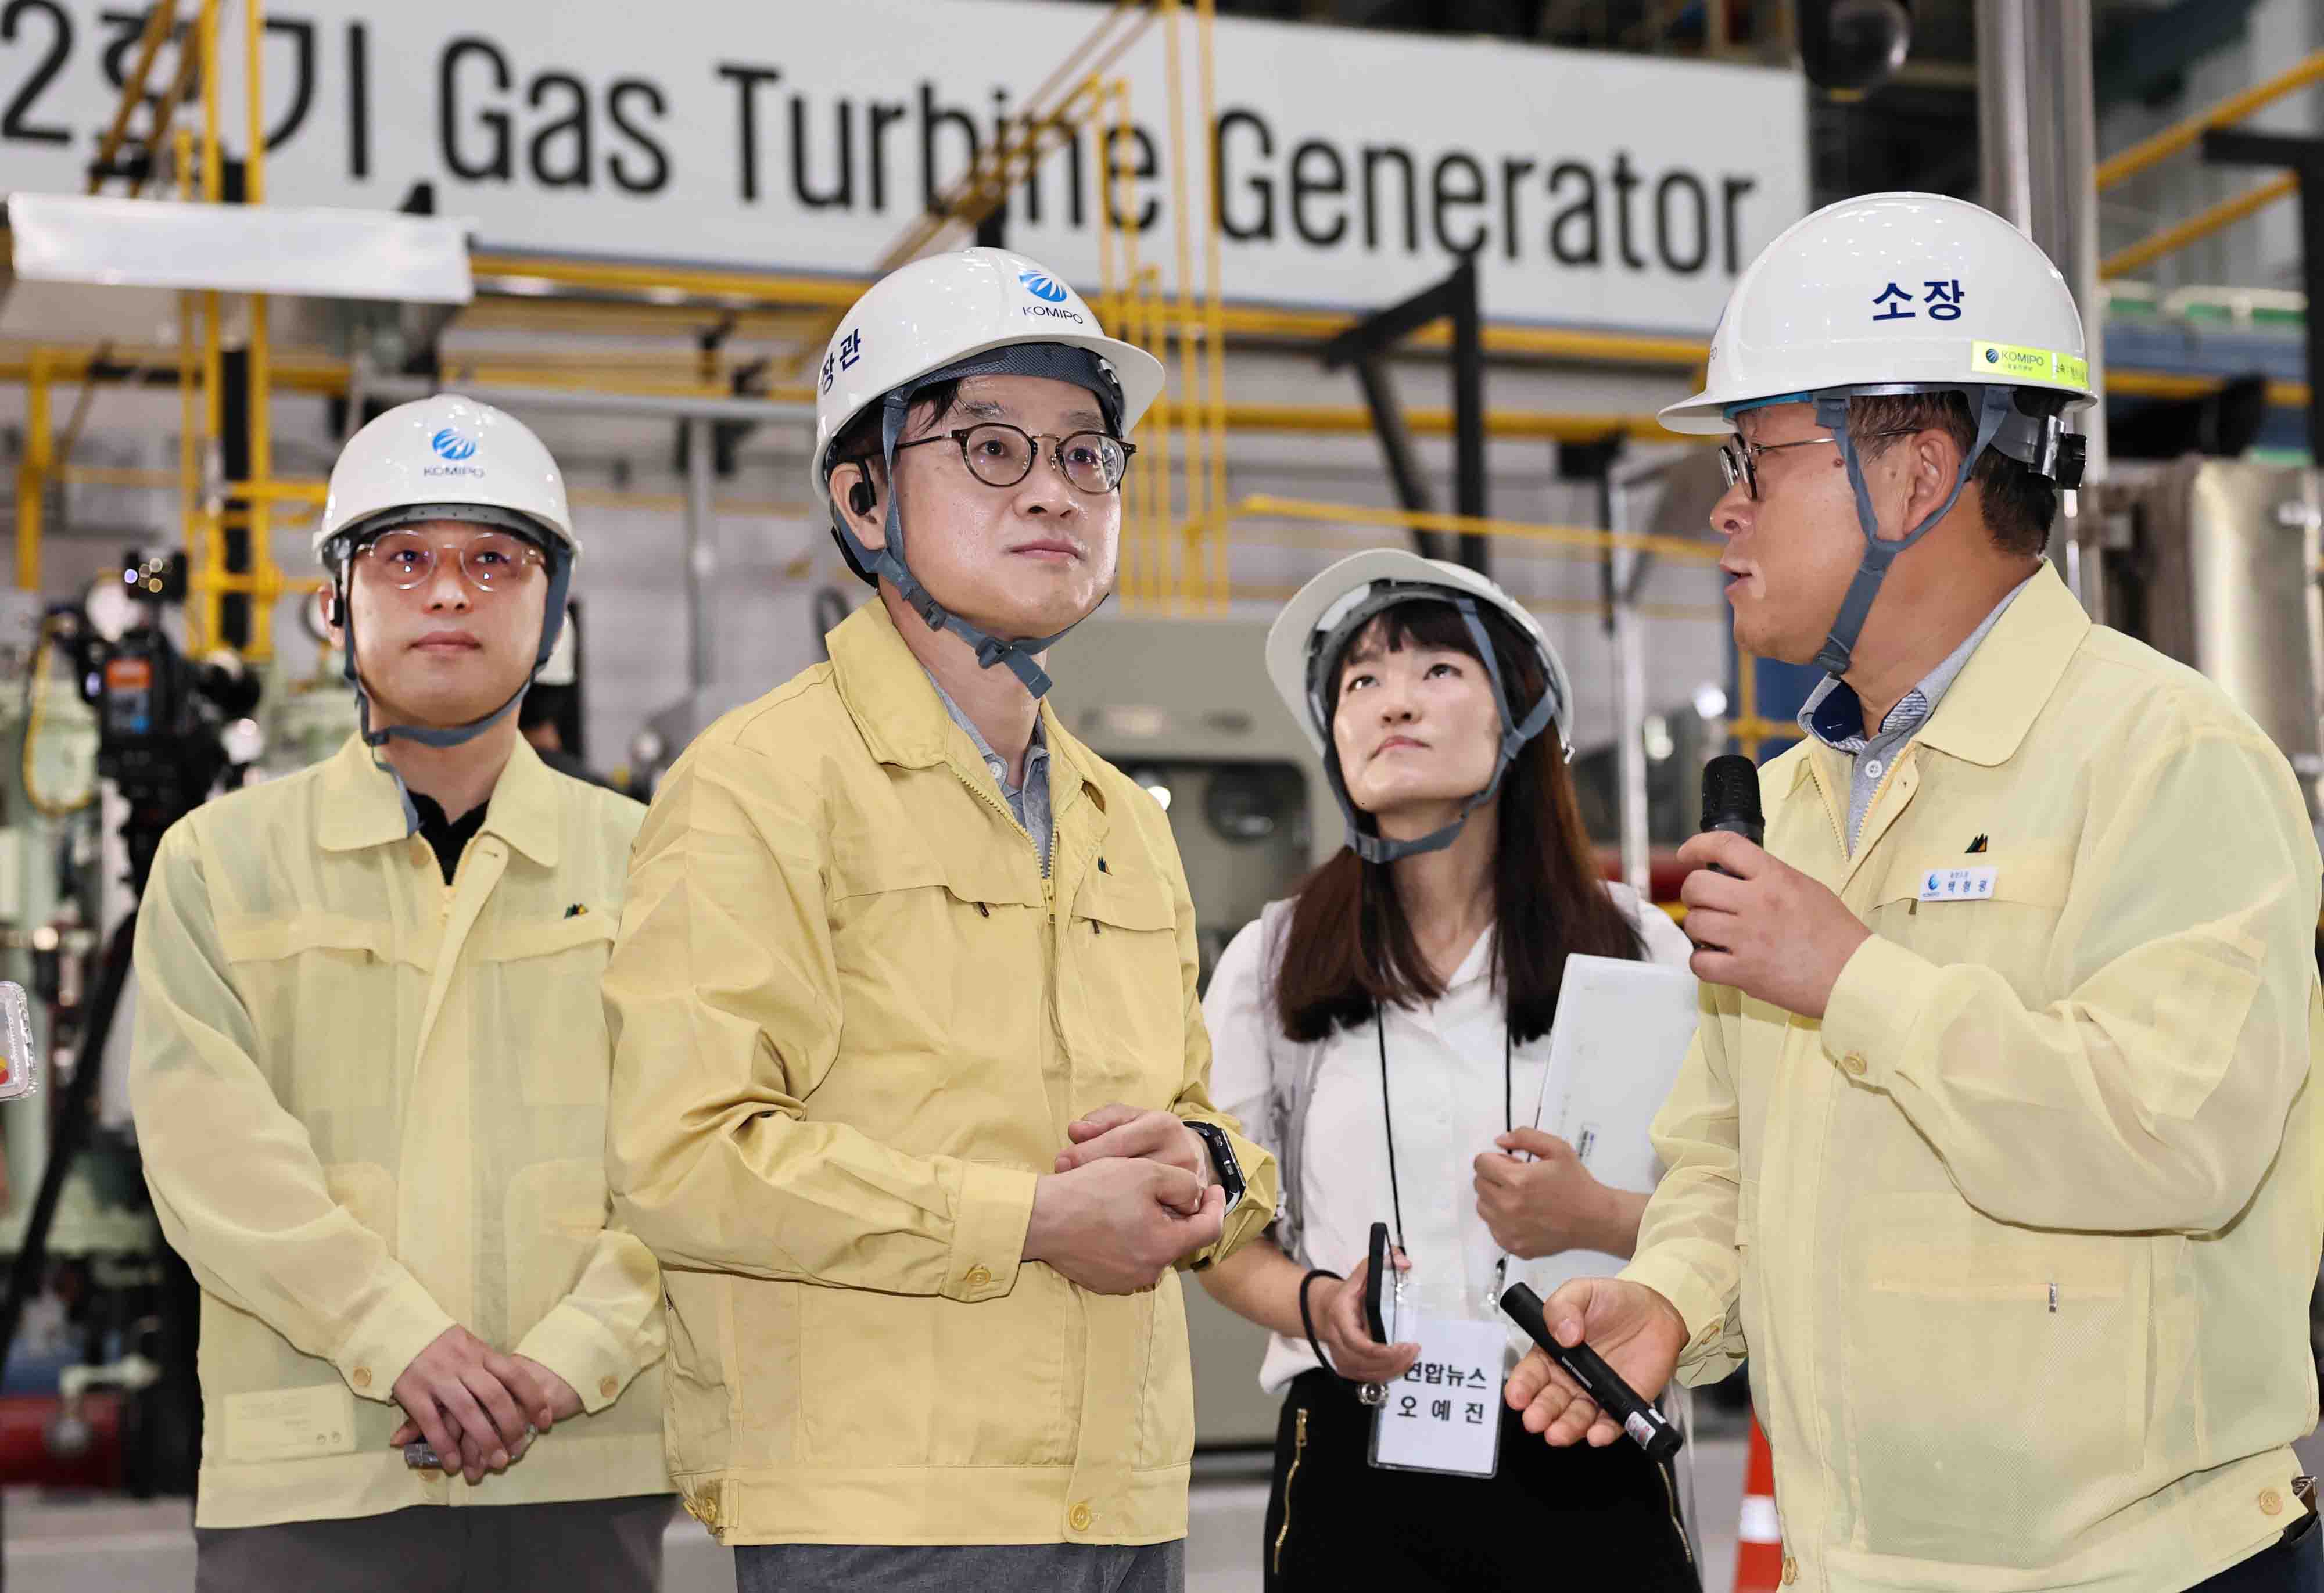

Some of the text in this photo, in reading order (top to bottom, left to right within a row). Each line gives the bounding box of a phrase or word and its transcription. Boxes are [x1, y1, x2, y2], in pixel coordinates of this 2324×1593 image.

[438, 33, 672, 196] Gas
[715, 63, 1160, 232] Turbine
[1215, 106, 1756, 278] Generator
[1872, 279, 1965, 321] 소장
[1022, 306, 1084, 324] KOMIPO
[2001, 350, 2045, 367] KOMIPO
[1397, 1395, 1483, 1424] 오 예 진
